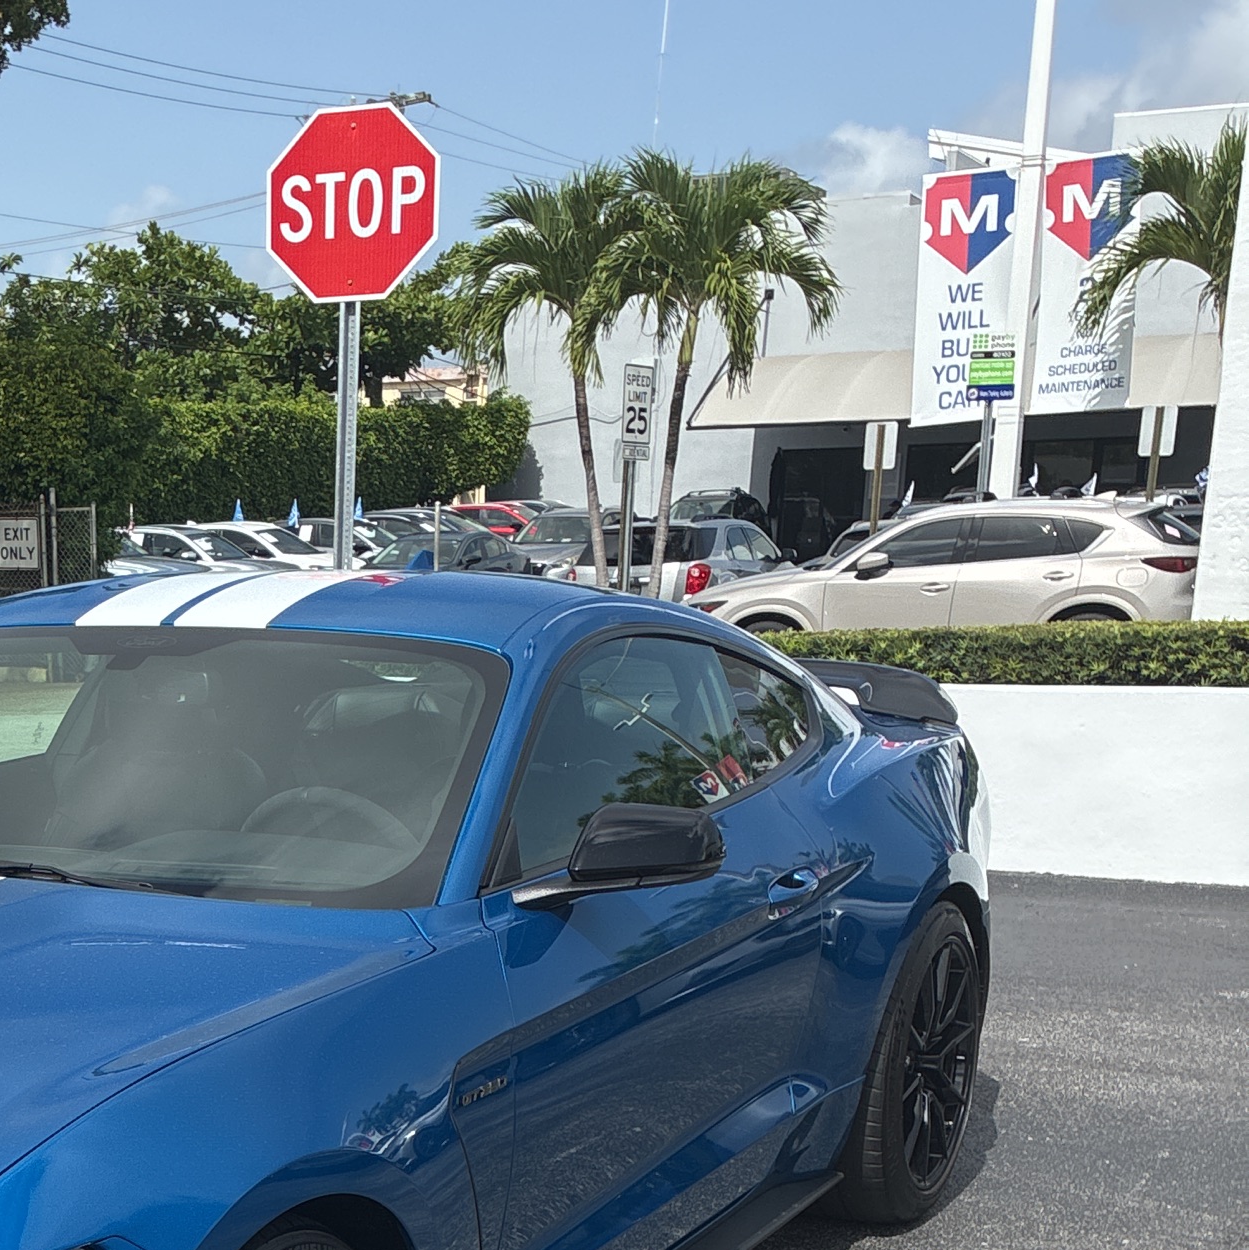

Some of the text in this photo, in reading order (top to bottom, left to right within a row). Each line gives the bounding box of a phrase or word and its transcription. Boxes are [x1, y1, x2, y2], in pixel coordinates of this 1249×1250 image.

[279, 165, 426, 244] STOP
[940, 194, 999, 237] M
[948, 282, 984, 304] WE
[938, 309, 990, 332] WILL
[941, 337, 970, 358] BU
[1060, 343, 1108, 358] CHARGE
[1048, 359, 1117, 376] SCHEDULED
[626, 374, 651, 387] SPEED
[1038, 376, 1125, 395] MAINTENANCE
[628, 390, 648, 404] LIMIT
[625, 406, 648, 435] 25
[4, 527, 31, 541] EXIT
[0, 546, 35, 560] ONLY
